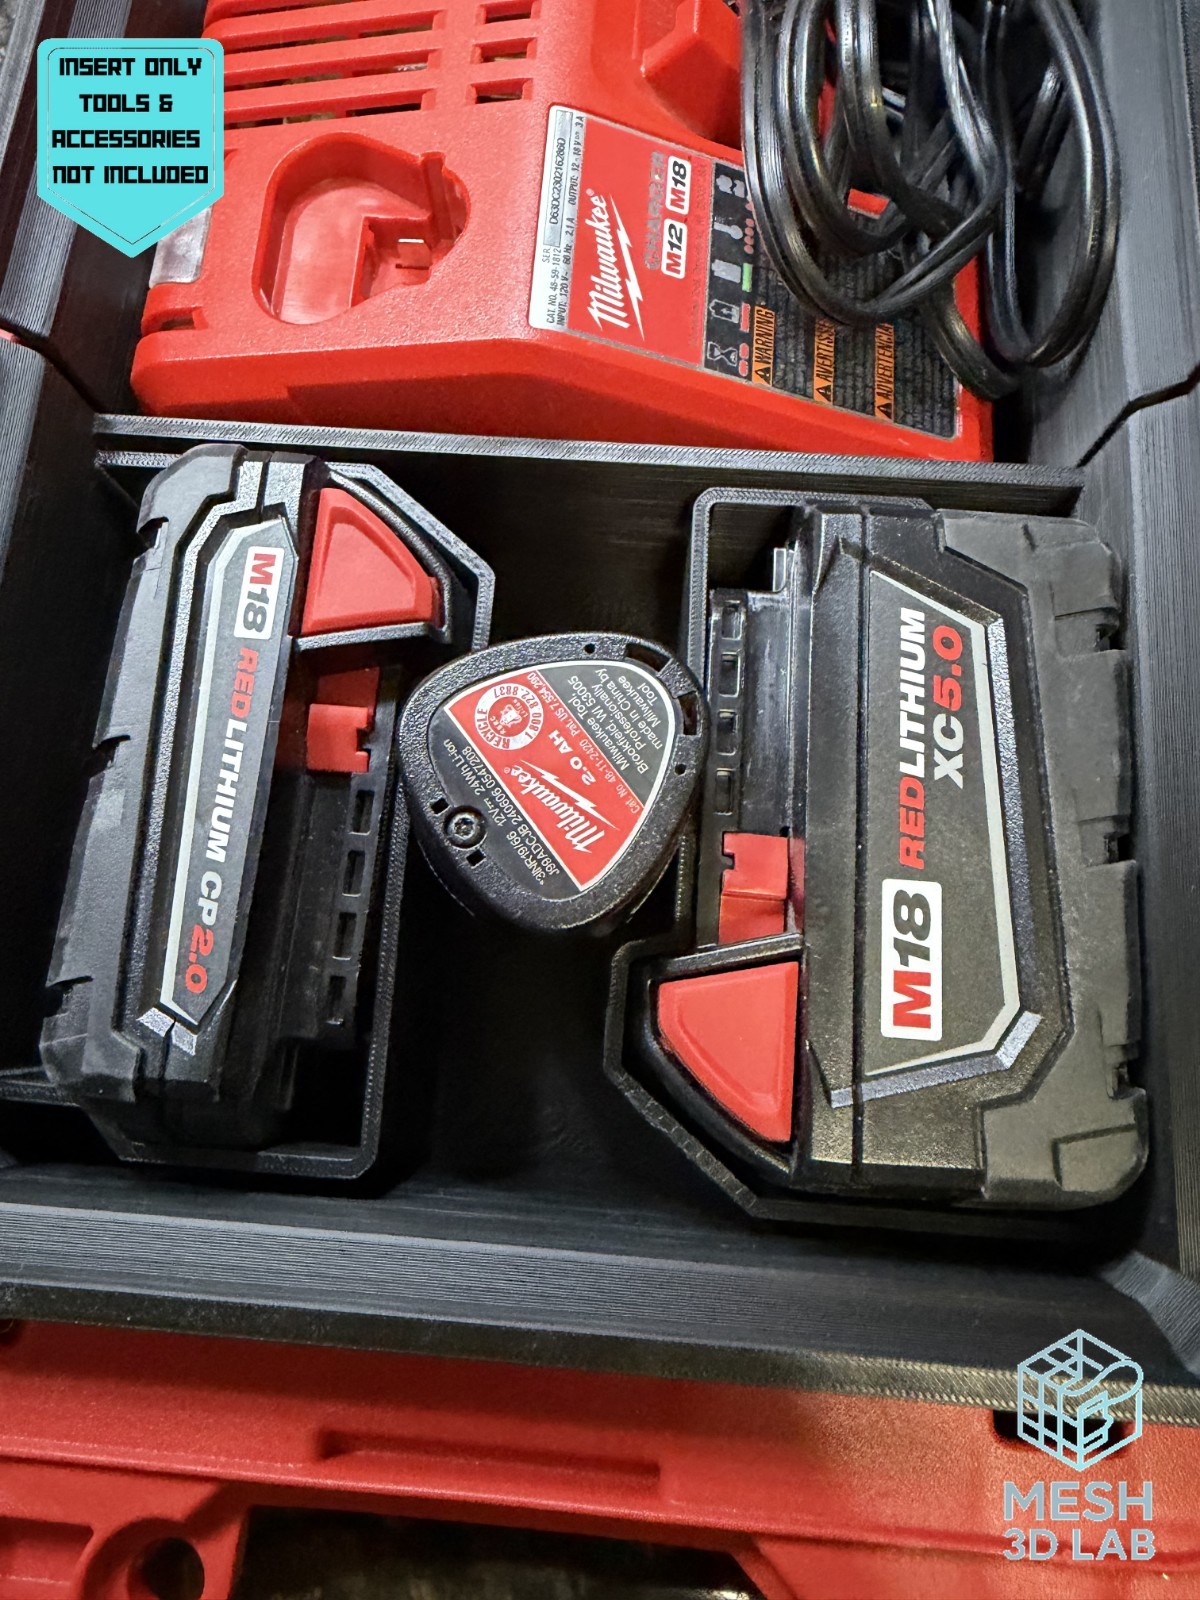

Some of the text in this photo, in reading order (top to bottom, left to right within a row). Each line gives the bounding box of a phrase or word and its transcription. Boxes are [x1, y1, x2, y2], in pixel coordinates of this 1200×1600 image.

[665, 160, 688, 276] M12 M18
[585, 192, 631, 330] Milwaukee
[754, 308, 775, 365] WARNING
[875, 323, 895, 400] ADVERTENCIA
[242, 552, 277, 633] M18
[554, 707, 567, 720] US
[591, 666, 662, 750] made in China by
[591, 681, 646, 749] Professionally
[617, 674, 660, 727] Milwaukee
[637, 682, 658, 705] Tool
[441, 739, 464, 765] Li-ion
[475, 706, 511, 749] RECYCLE
[563, 719, 580, 737] Pat.
[568, 675, 648, 773] Brookfield, WI 53005
[585, 716, 629, 770] Milwaukee
[206, 647, 259, 863] REDLITHIUM
[459, 765, 484, 794] 24Wh
[461, 746, 495, 787] 0547208
[549, 729, 594, 785] 2.0 AH
[579, 738, 616, 783] 48-11-2420
[491, 787, 521, 824] 240606
[509, 764, 606, 854] Milwaukee
[892, 607, 932, 1030] M18 REDLITHIUM
